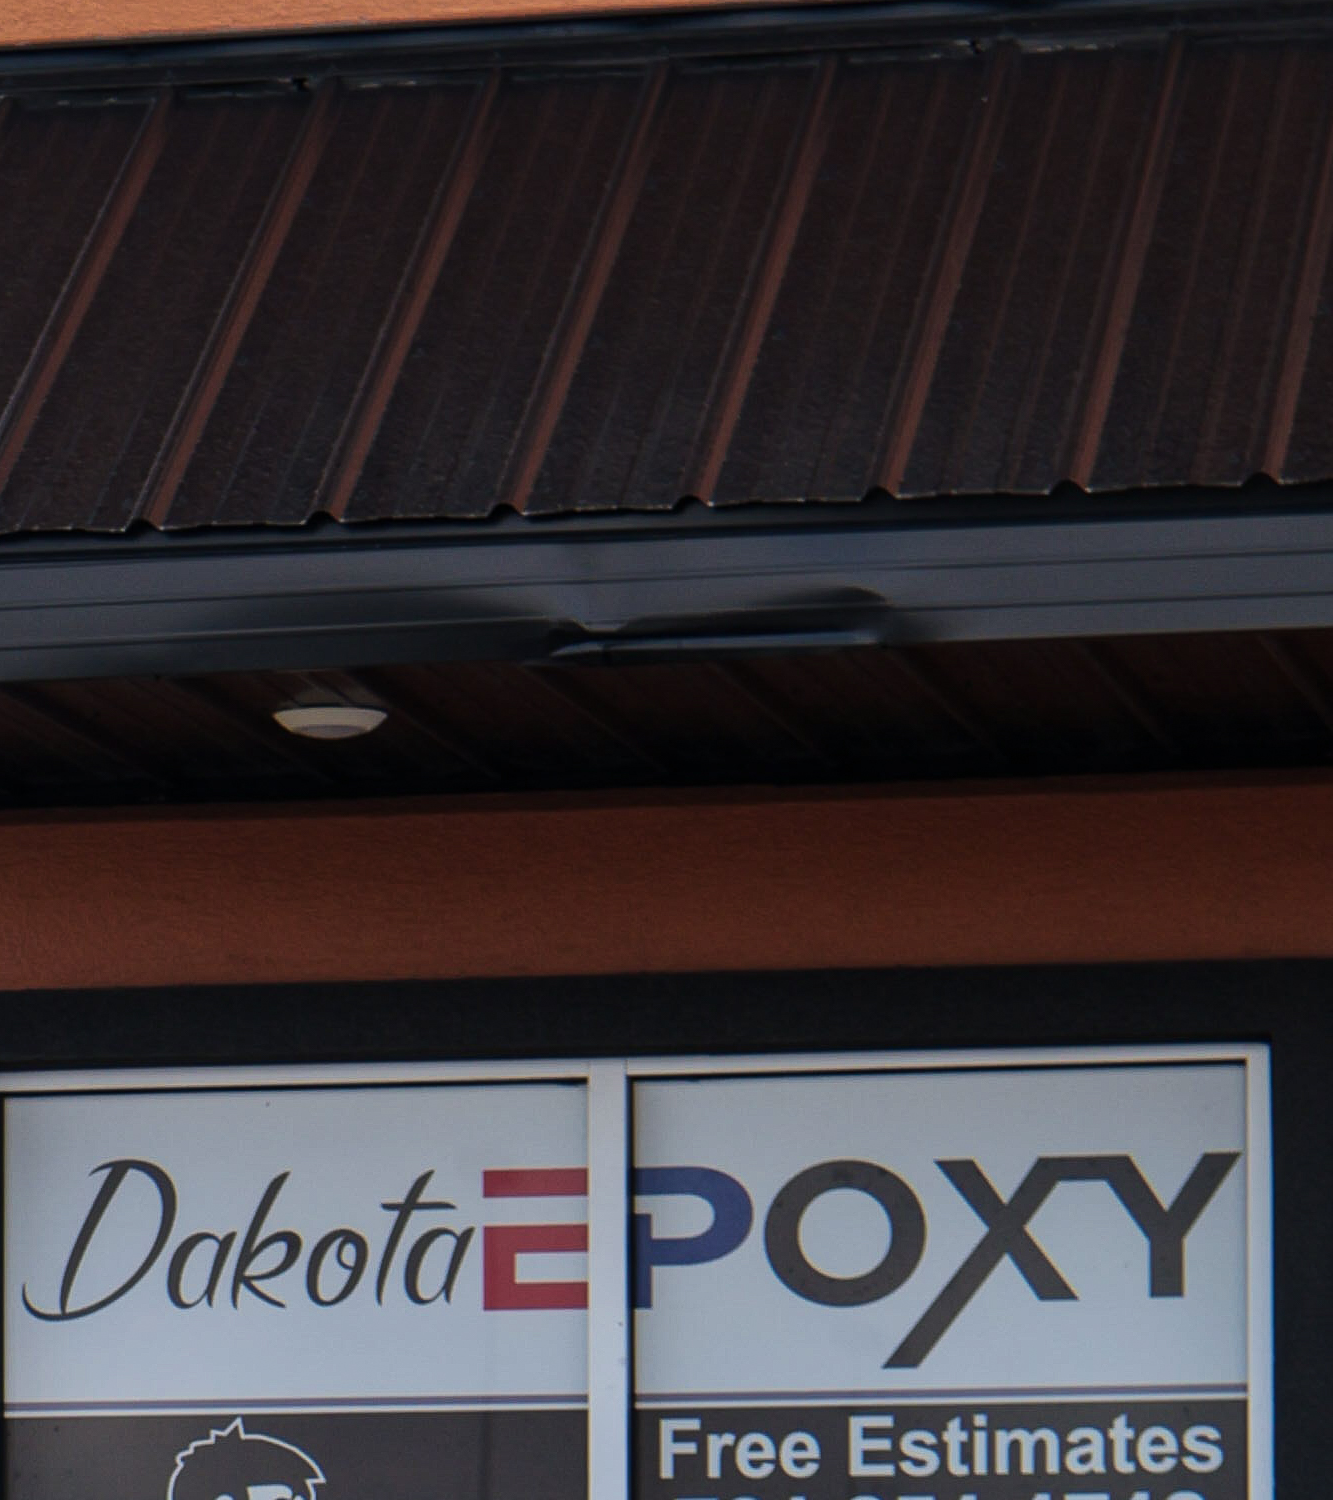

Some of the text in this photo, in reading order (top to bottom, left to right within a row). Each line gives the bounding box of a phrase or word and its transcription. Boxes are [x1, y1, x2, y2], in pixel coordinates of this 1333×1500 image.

[21, 1151, 1243, 1369] Dakota EPOXY
[657, 1412, 1225, 1480] Free Estimates
